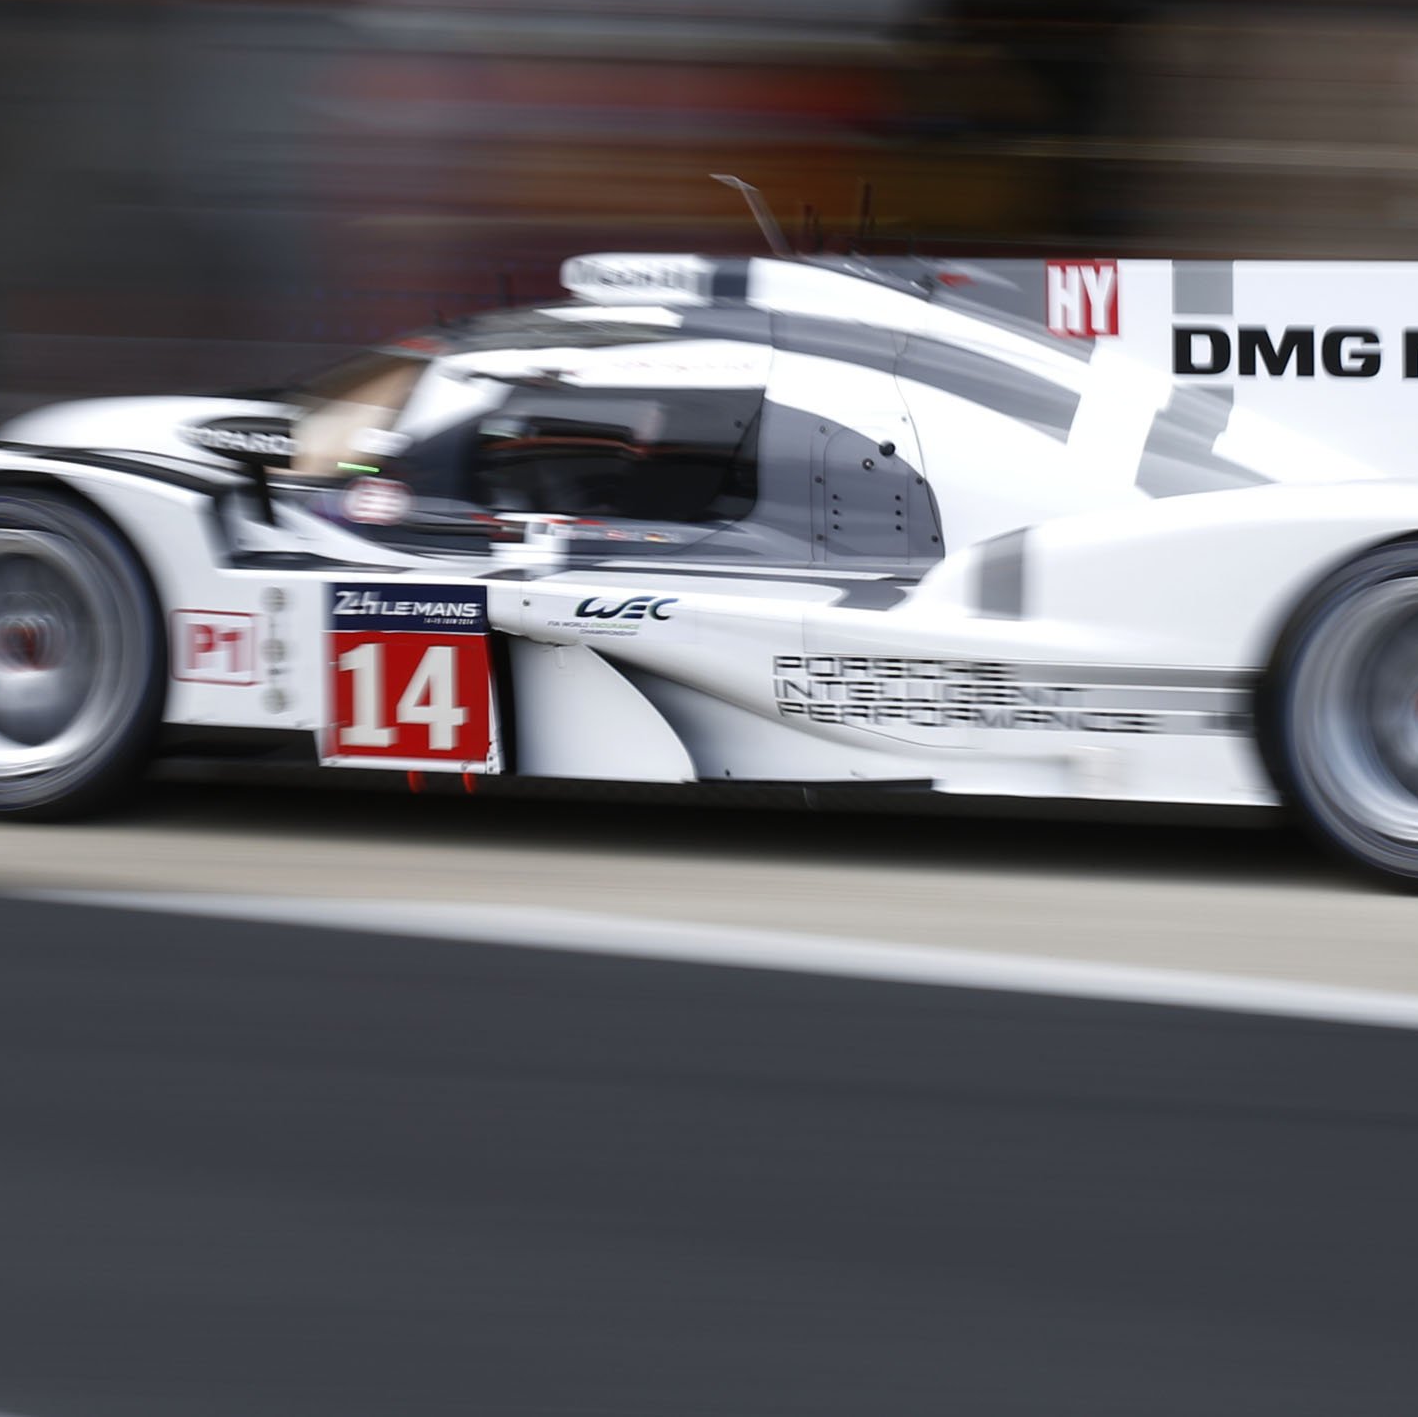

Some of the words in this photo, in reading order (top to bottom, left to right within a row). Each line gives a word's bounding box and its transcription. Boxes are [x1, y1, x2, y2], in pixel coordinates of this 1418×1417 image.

[1048, 264, 1115, 331] HY
[1172, 326, 1381, 378] DMG
[575, 595, 680, 621] WEC
[185, 623, 244, 673] P1
[774, 655, 1017, 682] PORSCHE
[338, 643, 469, 750] 14
[774, 679, 1086, 706] INTELLIGENT
[777, 701, 1160, 734] PERFORMANCE
